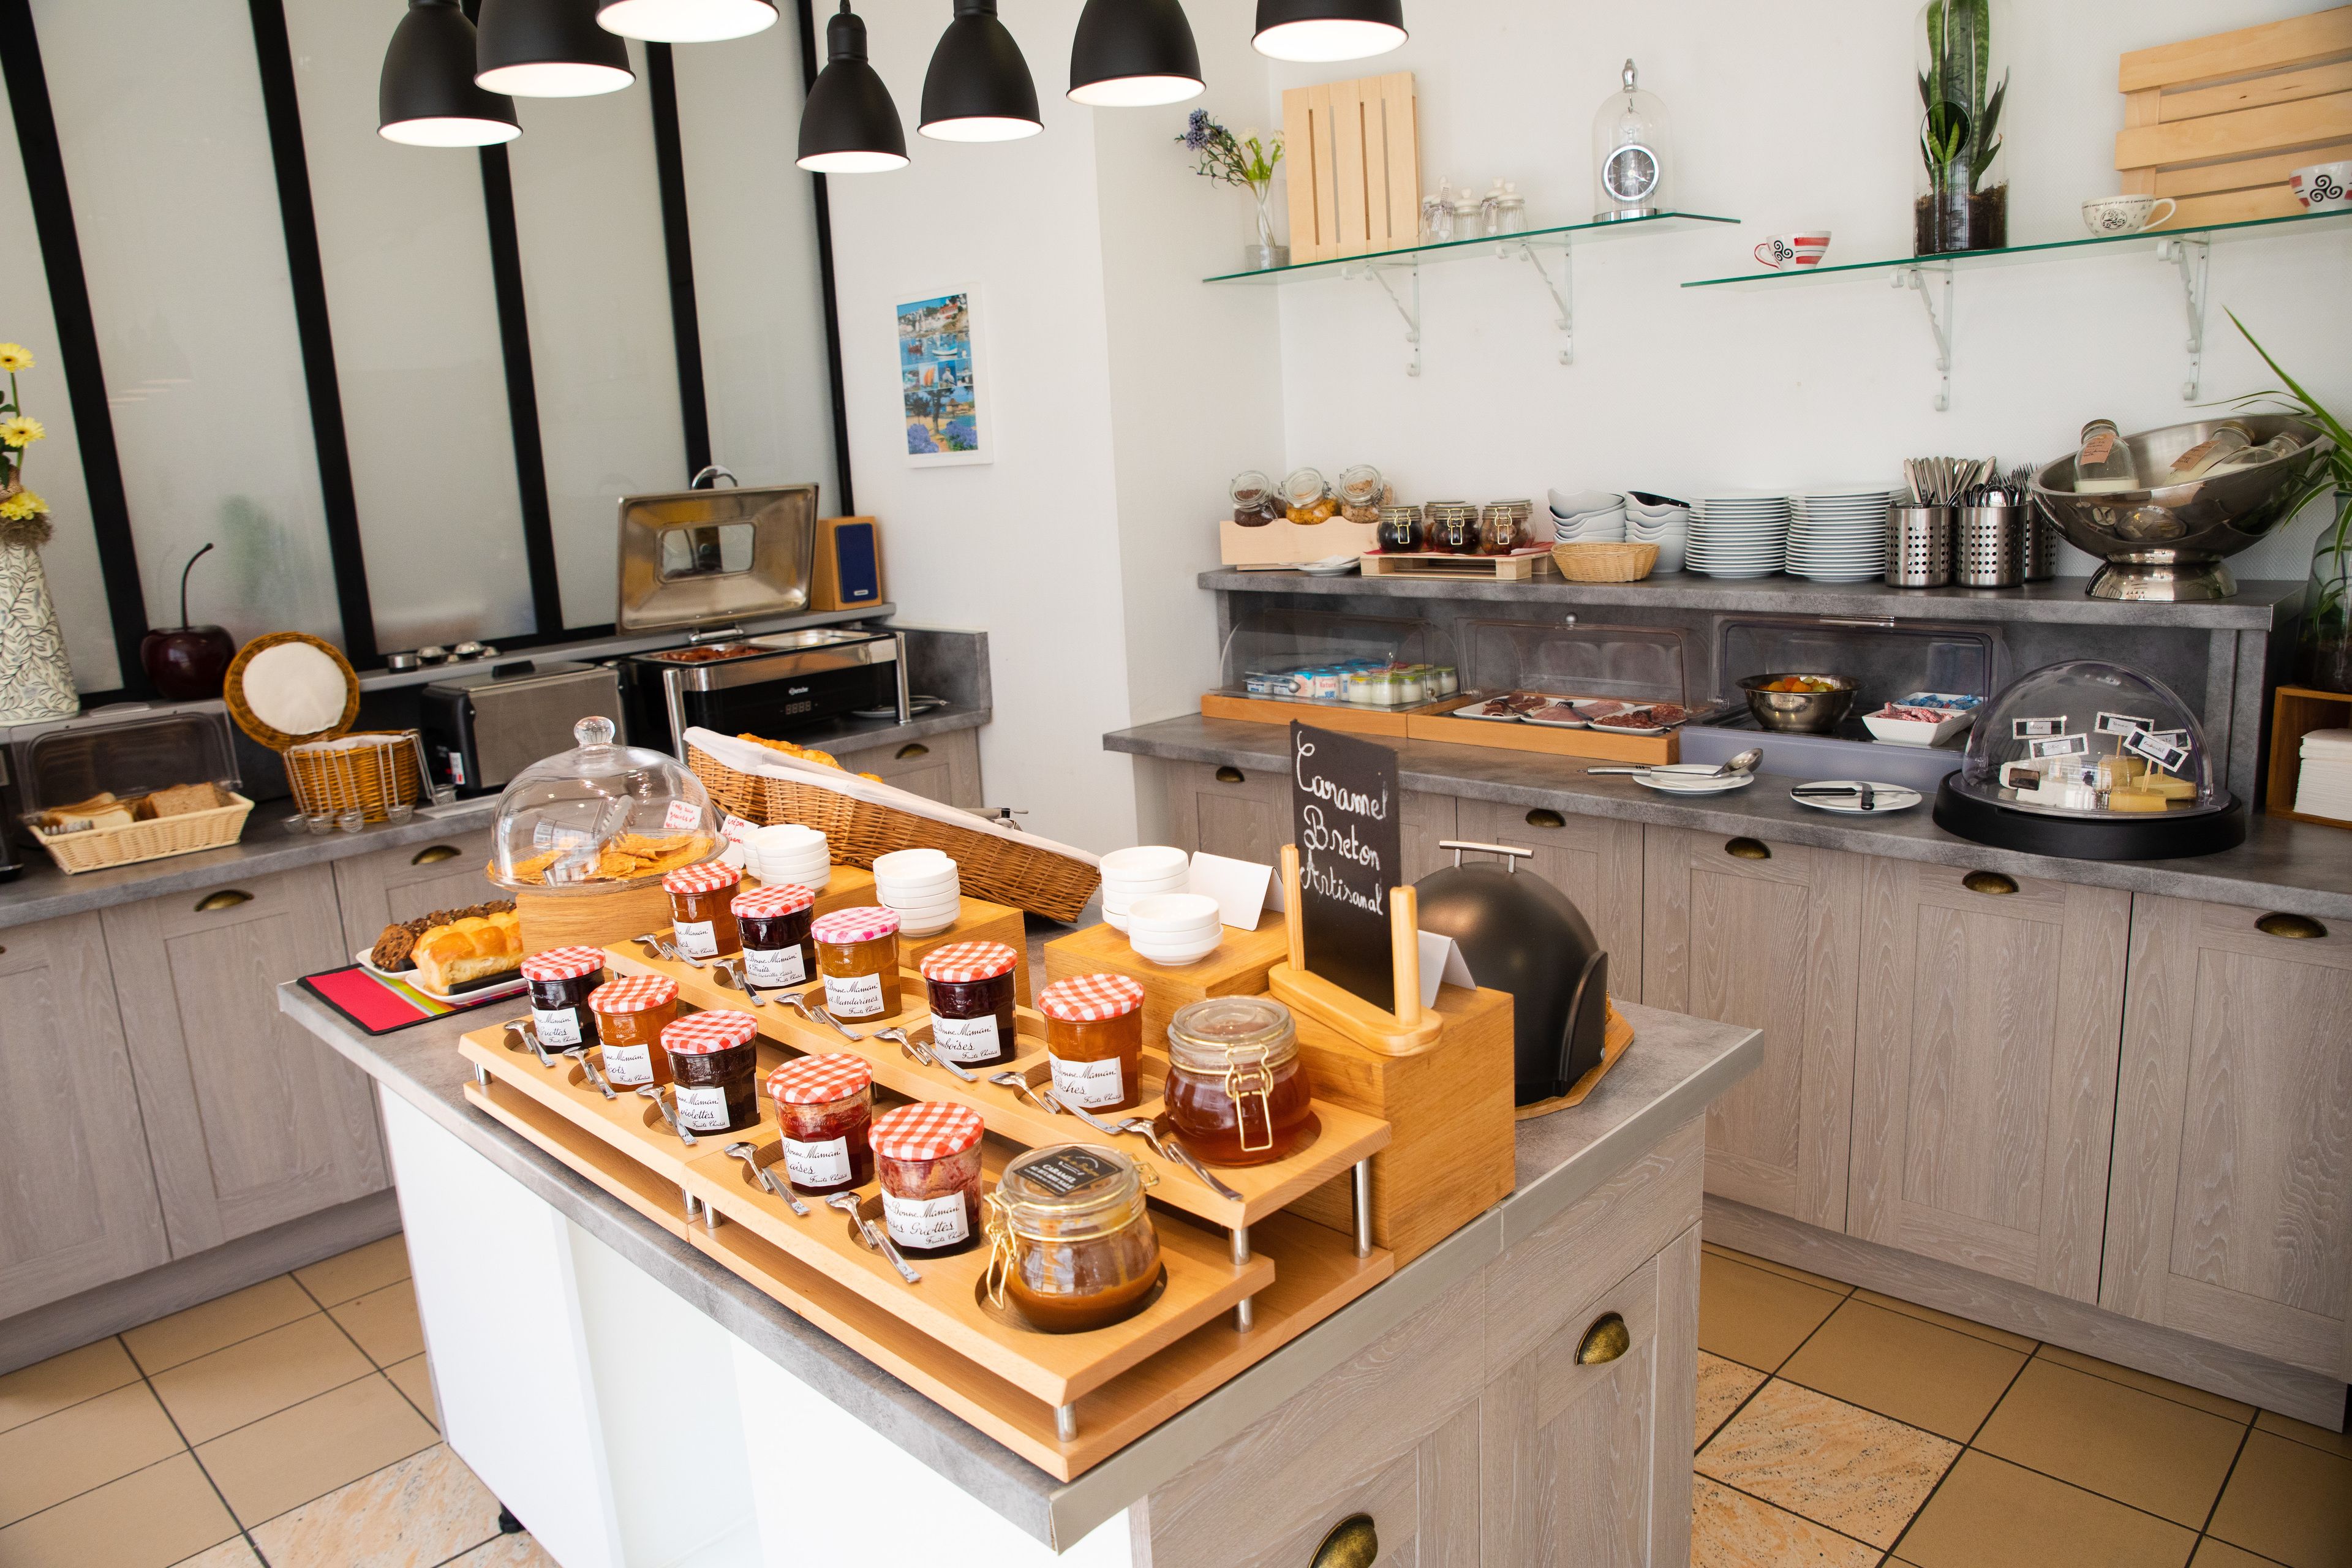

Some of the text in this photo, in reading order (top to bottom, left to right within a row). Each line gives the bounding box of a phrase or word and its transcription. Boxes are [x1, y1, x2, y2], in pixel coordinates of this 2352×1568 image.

[1296, 730, 1389, 821] Caramel
[1303, 805, 1380, 872] Breton
[1299, 849, 1384, 916] Artisanal
[748, 951, 796, 963] Bonne Maman
[752, 963, 770, 973] Fruits
[827, 979, 877, 993] Bonne Maman
[834, 995, 879, 1006] Mandarines
[937, 1019, 957, 1035] Bonne
[957, 1023, 990, 1036] Maman
[614, 1050, 643, 1061] Maman
[1055, 1061, 1116, 1079] Bonne Maman
[1055, 1074, 1087, 1095] Pêches
[687, 1093, 719, 1106] Maman
[680, 1109, 714, 1120] violettes
[783, 1140, 841, 1159] Bonne Maman
[789, 1162, 816, 1175] aises
[1042, 1164, 1076, 1183] CARAMEL
[809, 1175, 828, 1183] Fruits
[892, 1200, 919, 1218] Bonne
[919, 1202, 960, 1218] Maman
[909, 1221, 956, 1237] Griottes
[925, 1235, 946, 1245] Fruits
